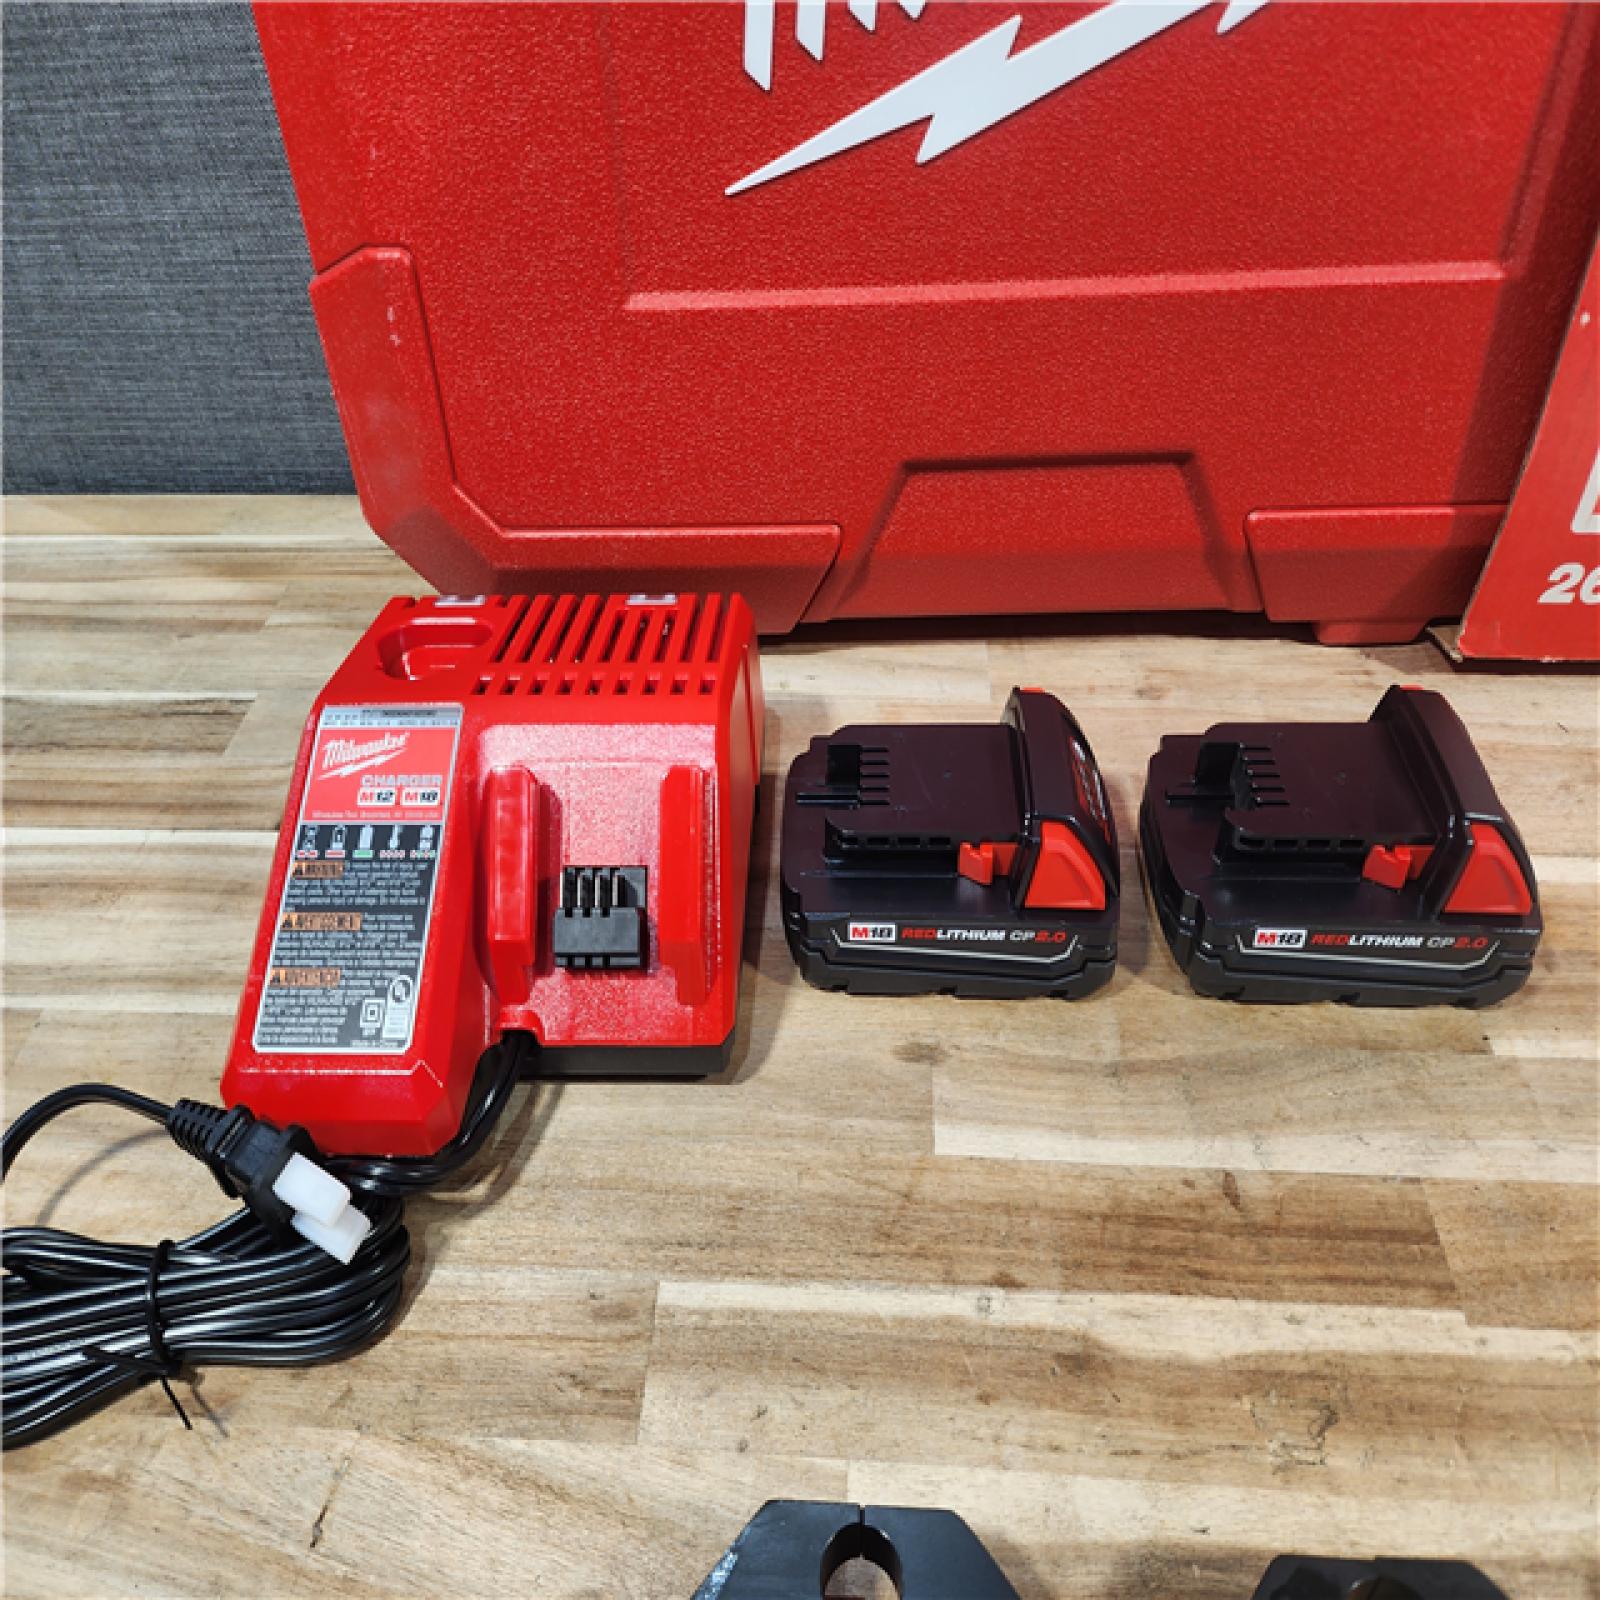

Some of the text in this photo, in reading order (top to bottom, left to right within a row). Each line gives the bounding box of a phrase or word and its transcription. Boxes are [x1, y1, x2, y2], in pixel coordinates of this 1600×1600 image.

[361, 774, 443, 786] CHARGER
[359, 789, 439, 803] M12 M18
[851, 925, 894, 940] M18
[1256, 930, 1304, 946] M18
